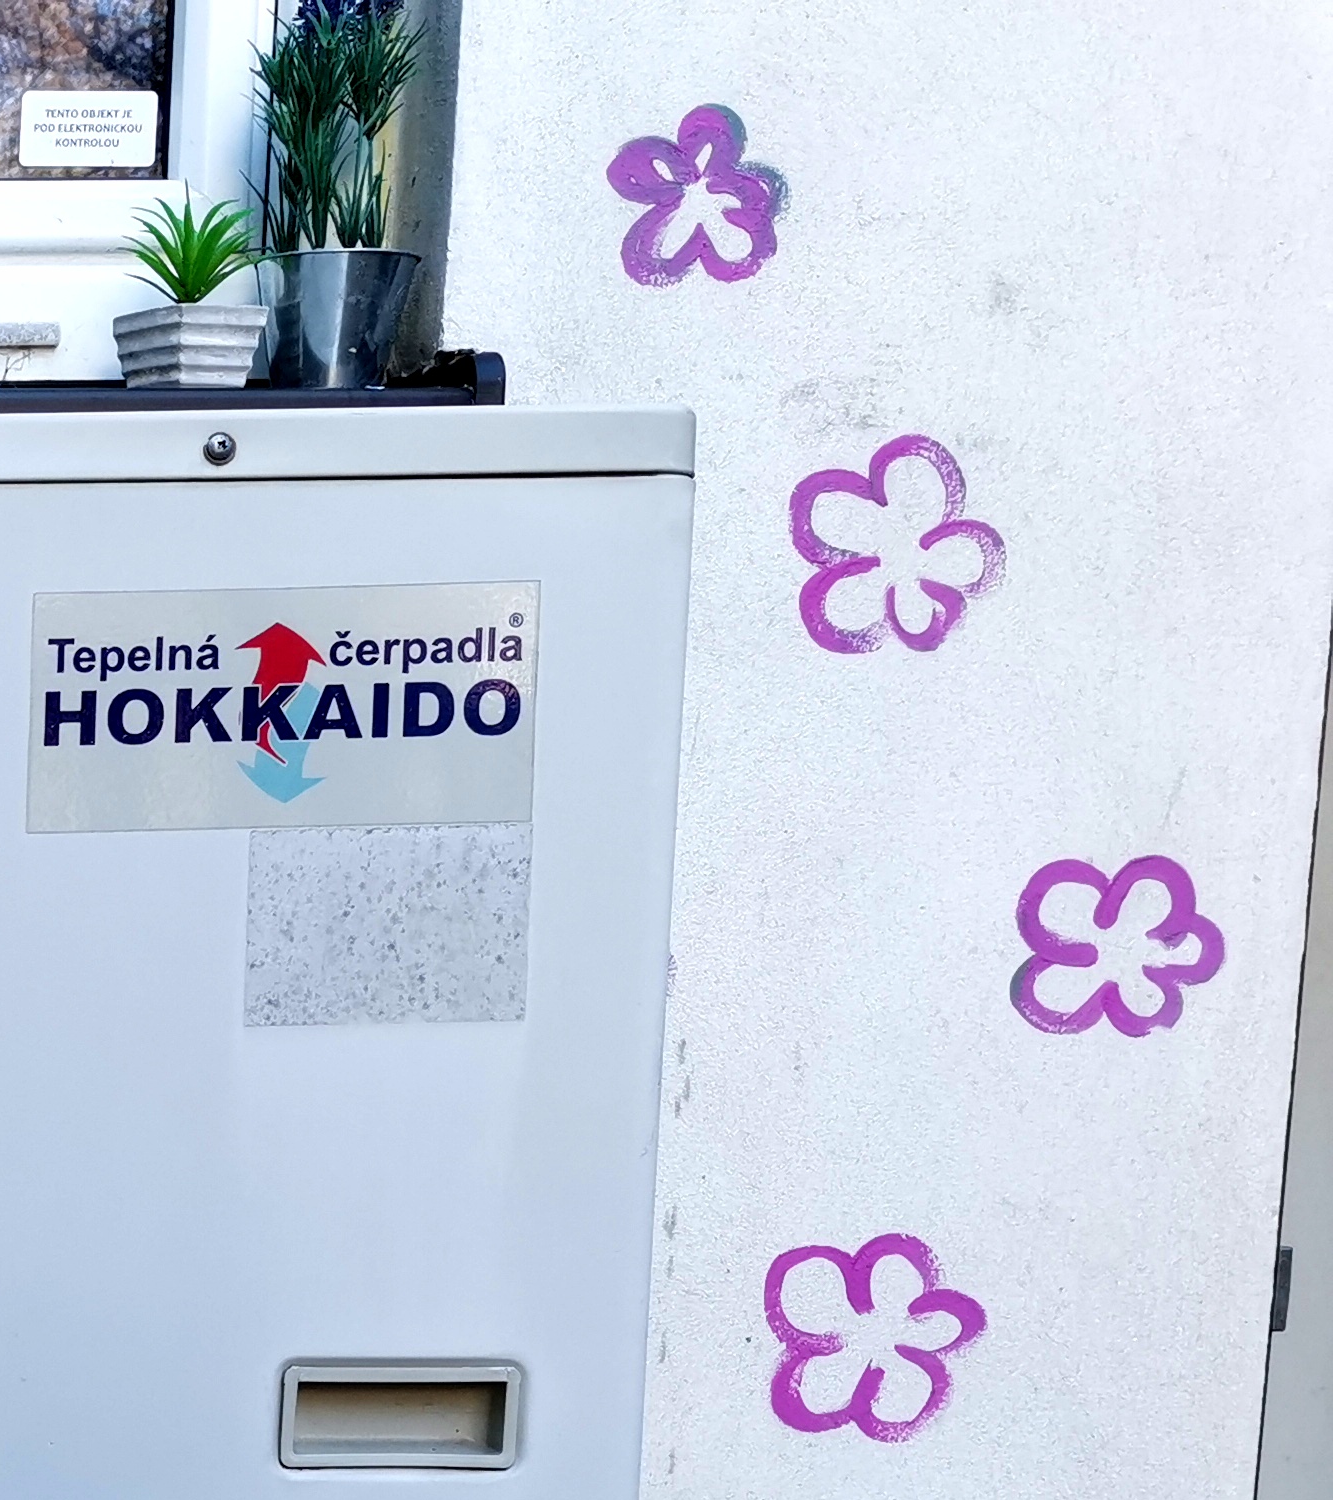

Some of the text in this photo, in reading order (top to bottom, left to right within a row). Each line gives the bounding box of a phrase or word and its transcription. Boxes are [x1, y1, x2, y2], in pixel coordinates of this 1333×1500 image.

[45, 109, 133, 118] TENTO OBJEKT JE
[34, 123, 143, 133] POD ELEKTRONICKOU
[55, 138, 120, 147] KONTROLOU
[47, 627, 523, 682] Tepelná čerpadla
[43, 679, 521, 747] HOKKAIDO
